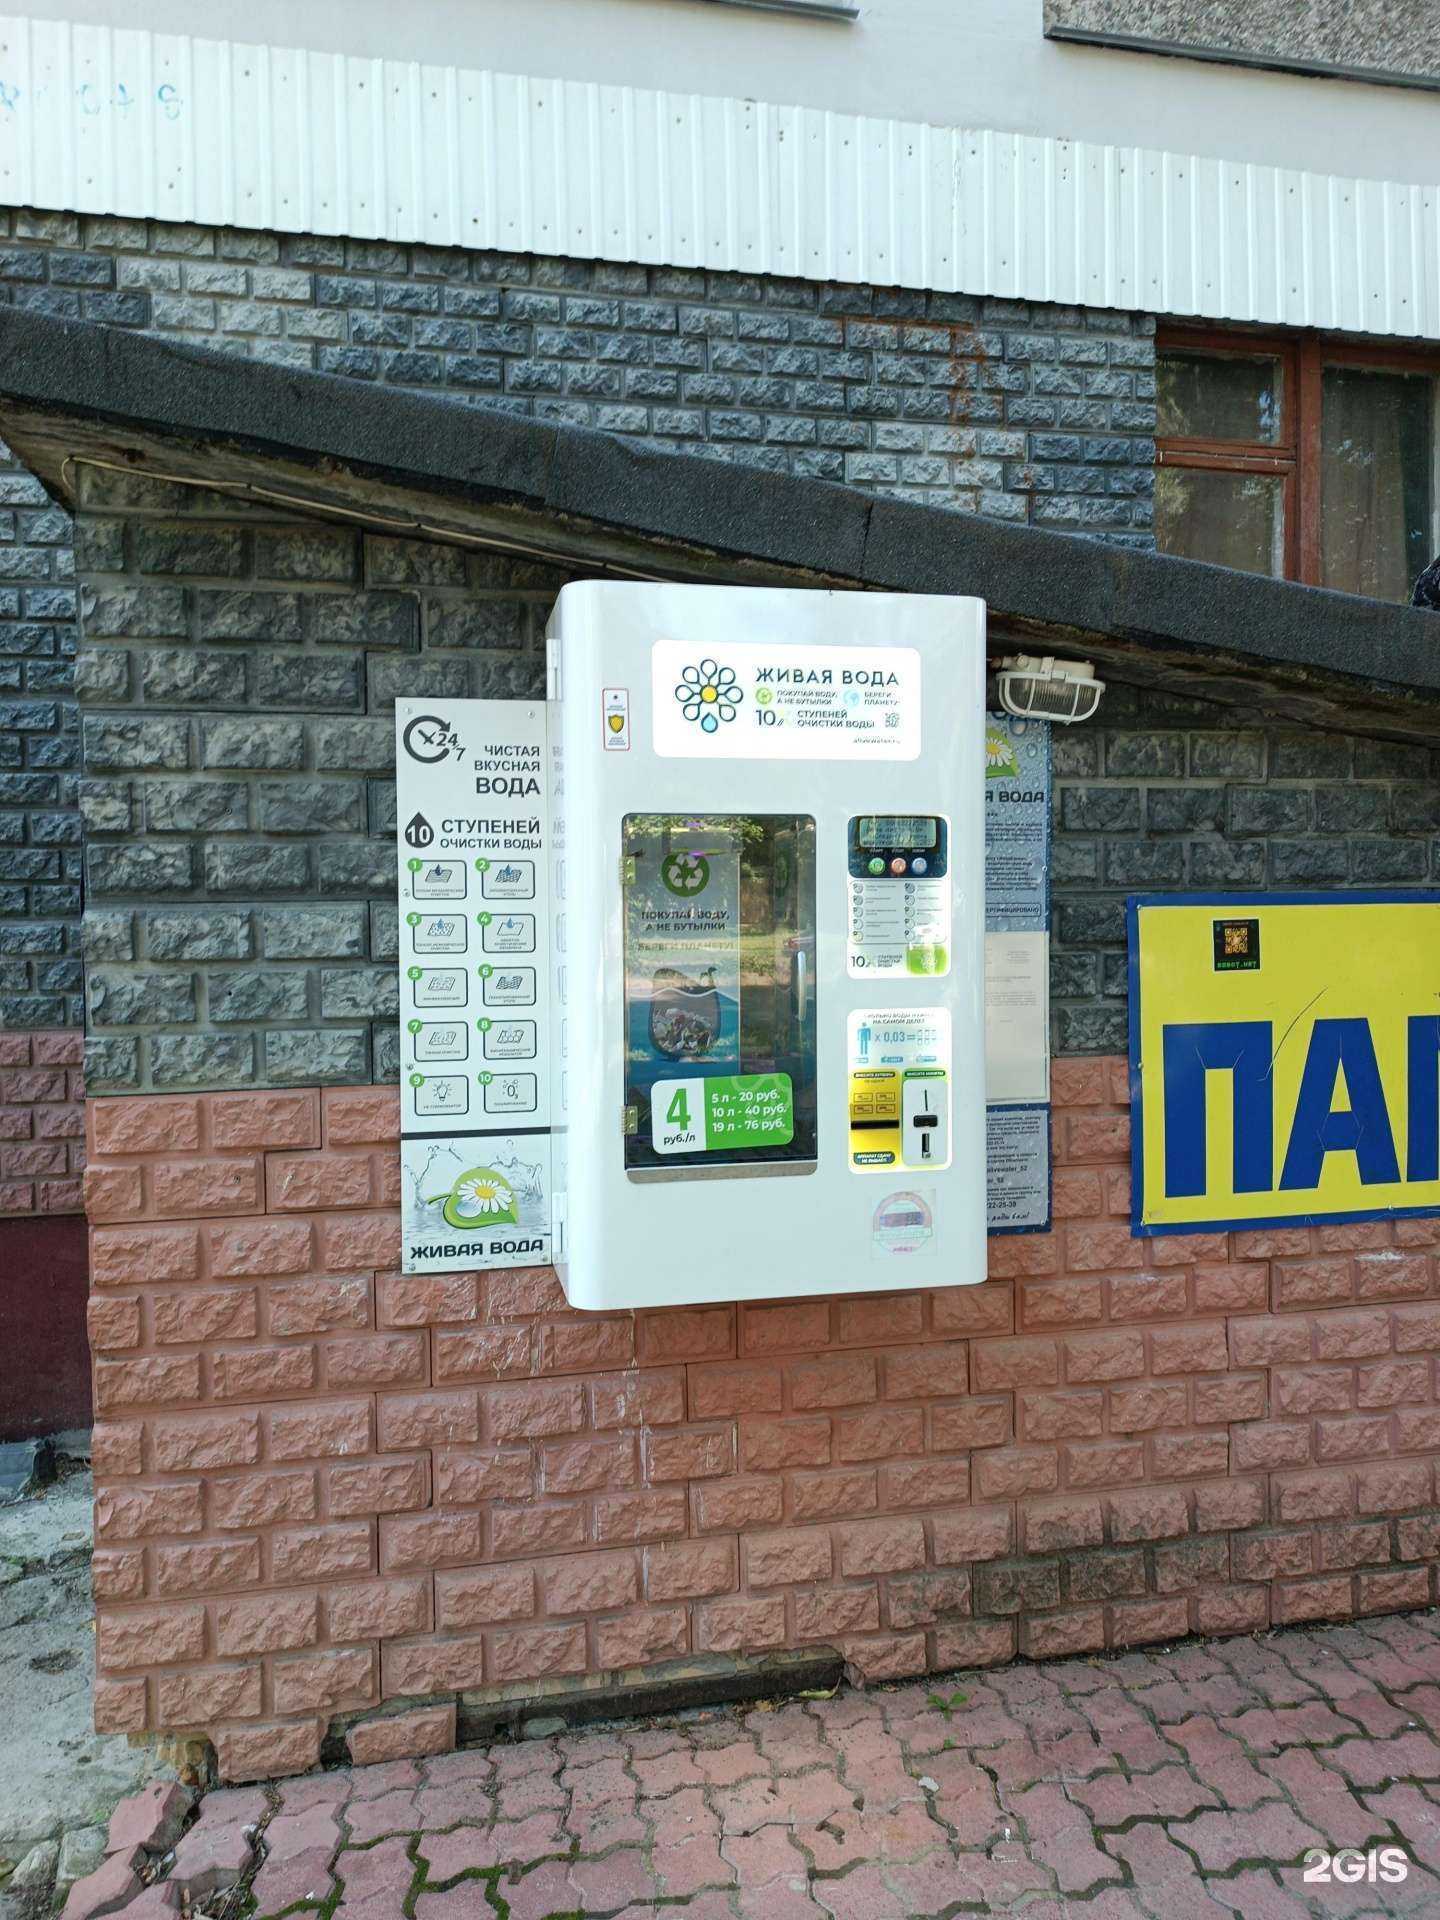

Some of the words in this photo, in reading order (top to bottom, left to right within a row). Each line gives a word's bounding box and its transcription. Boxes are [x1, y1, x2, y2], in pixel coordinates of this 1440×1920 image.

[755, 667, 832, 684] ЖИВАЯ
[842, 670, 899, 687] ВОДА
[755, 710, 776, 726] 10
[797, 709, 847, 719] СТУПЕНЕЙ
[797, 719, 843, 728] ОЧИСТКИ
[845, 720, 874, 729] ВОДЫ
[484, 745, 540, 757] ЧИСТАЯ
[474, 760, 540, 772] ВКУСНАЯ
[476, 777, 541, 798] ВОДА
[999, 791, 1045, 803] ВОДА
[441, 816, 540, 834] СТУПЕНЕЙ
[407, 825, 432, 844] 10
[440, 838, 500, 849] ОЧИСТКИ
[503, 838, 542, 850] ВОДЫ
[656, 923, 670, 931] НЕ
[674, 922, 726, 931] БУТЫЛКИ
[851, 956, 866, 968] 10
[711, 1094, 719, 1104] 5
[722, 1095, 729, 1103] л
[739, 1091, 754, 1101] 20
[756, 1090, 781, 1103] руб.
[666, 1088, 691, 1131] 4
[711, 1108, 725, 1118] 10
[728, 1109, 735, 1117] л
[744, 1105, 760, 1115] 40
[762, 1103, 787, 1117] руб.
[711, 1122, 725, 1133] 19
[727, 1123, 735, 1132] л
[744, 1119, 759, 1130] 76
[761, 1118, 786, 1132] руб.
[663, 1132, 696, 1146] руб./л
[410, 1243, 483, 1260] ЖИВАЯ
[490, 1239, 544, 1255] ВОДА
